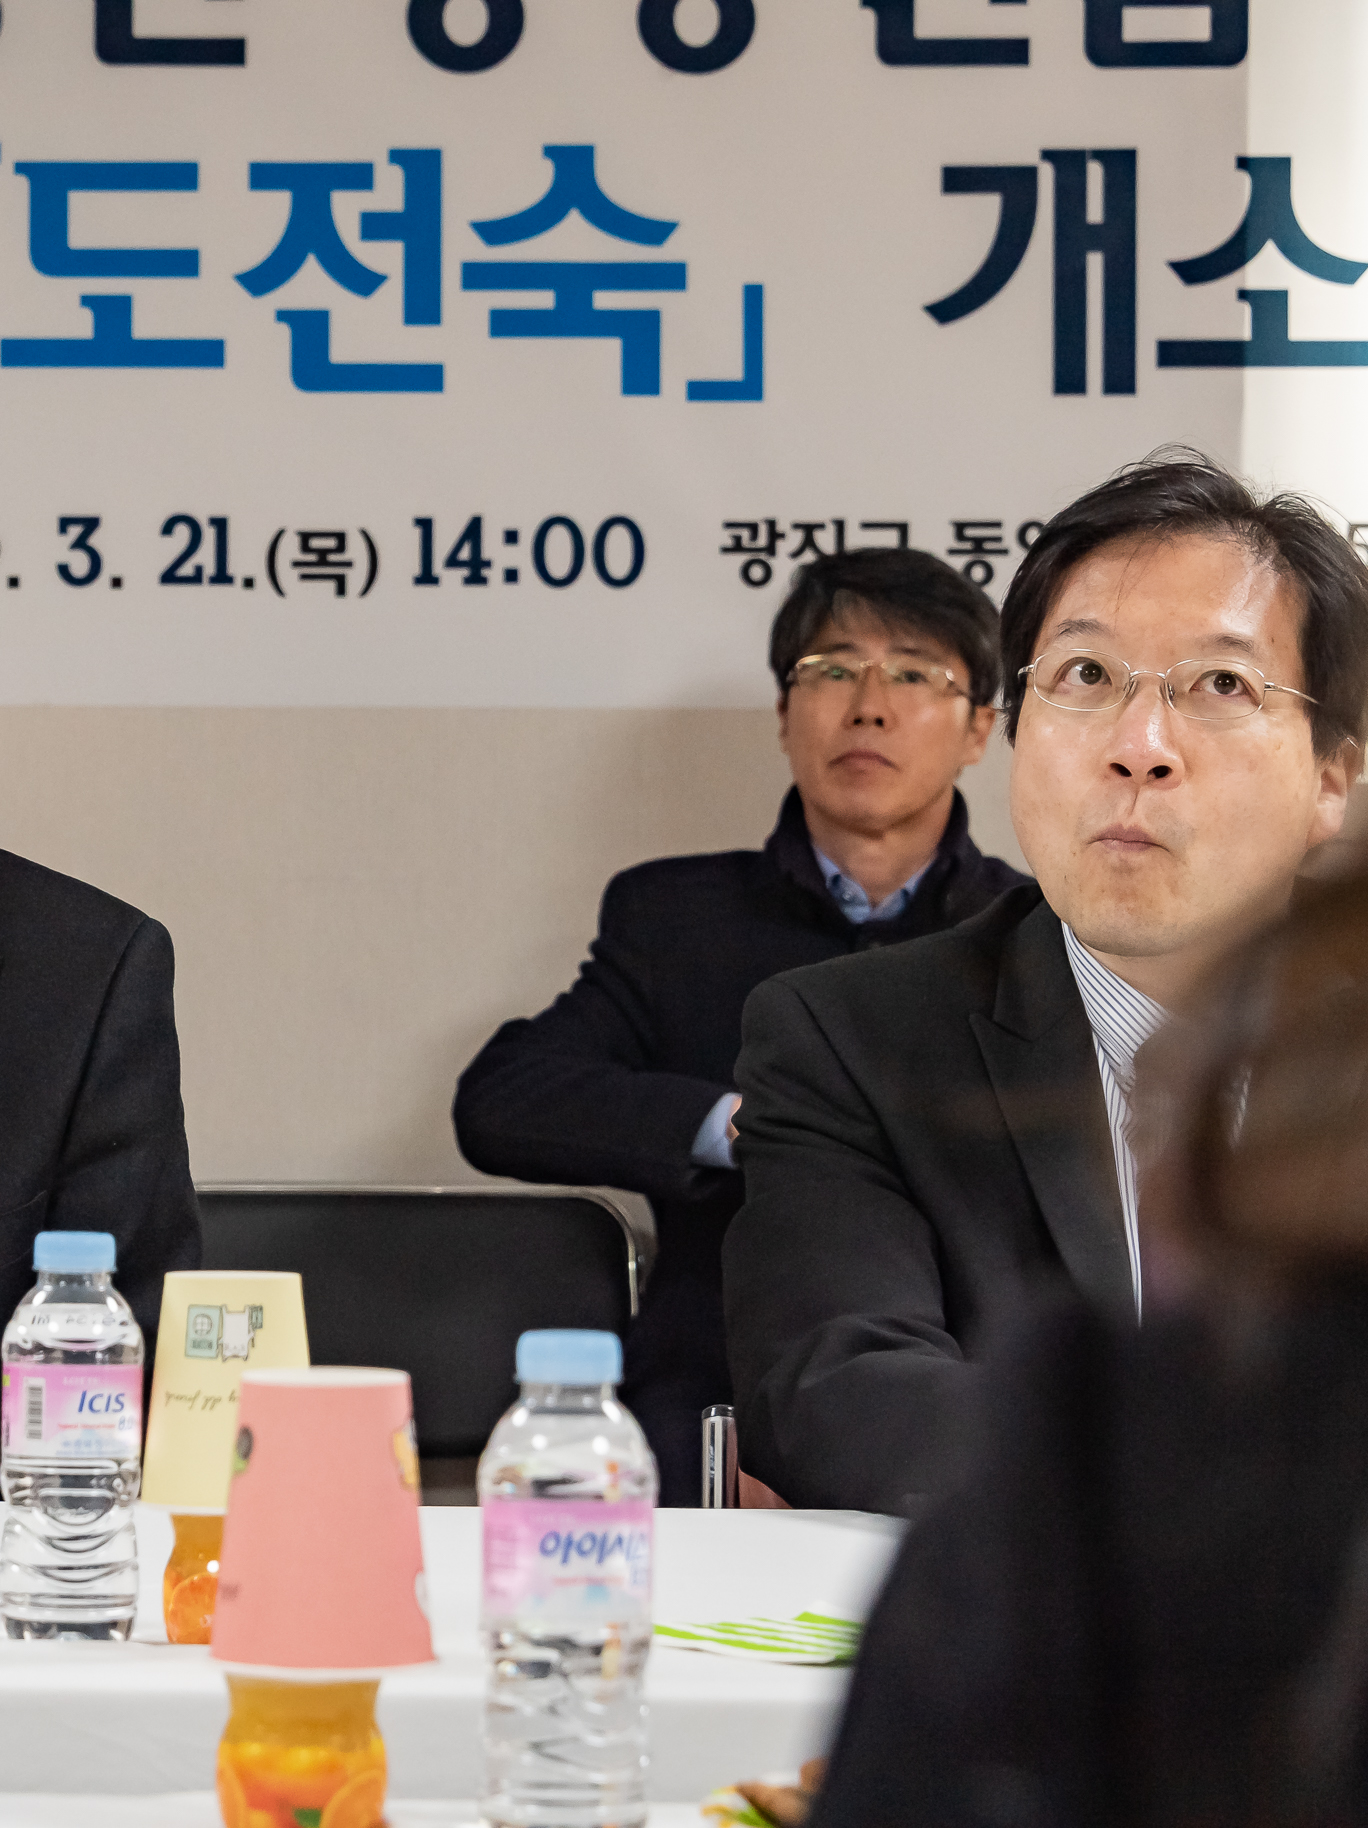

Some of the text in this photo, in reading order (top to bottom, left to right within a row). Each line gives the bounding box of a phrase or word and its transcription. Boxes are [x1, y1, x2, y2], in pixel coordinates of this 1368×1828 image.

[921, 147, 1368, 398] 개소
[55, 514, 124, 590] 3.
[158, 513, 380, 599] 21.(목)
[412, 514, 647, 589] 14:00
[77, 1390, 126, 1414] ICIS
